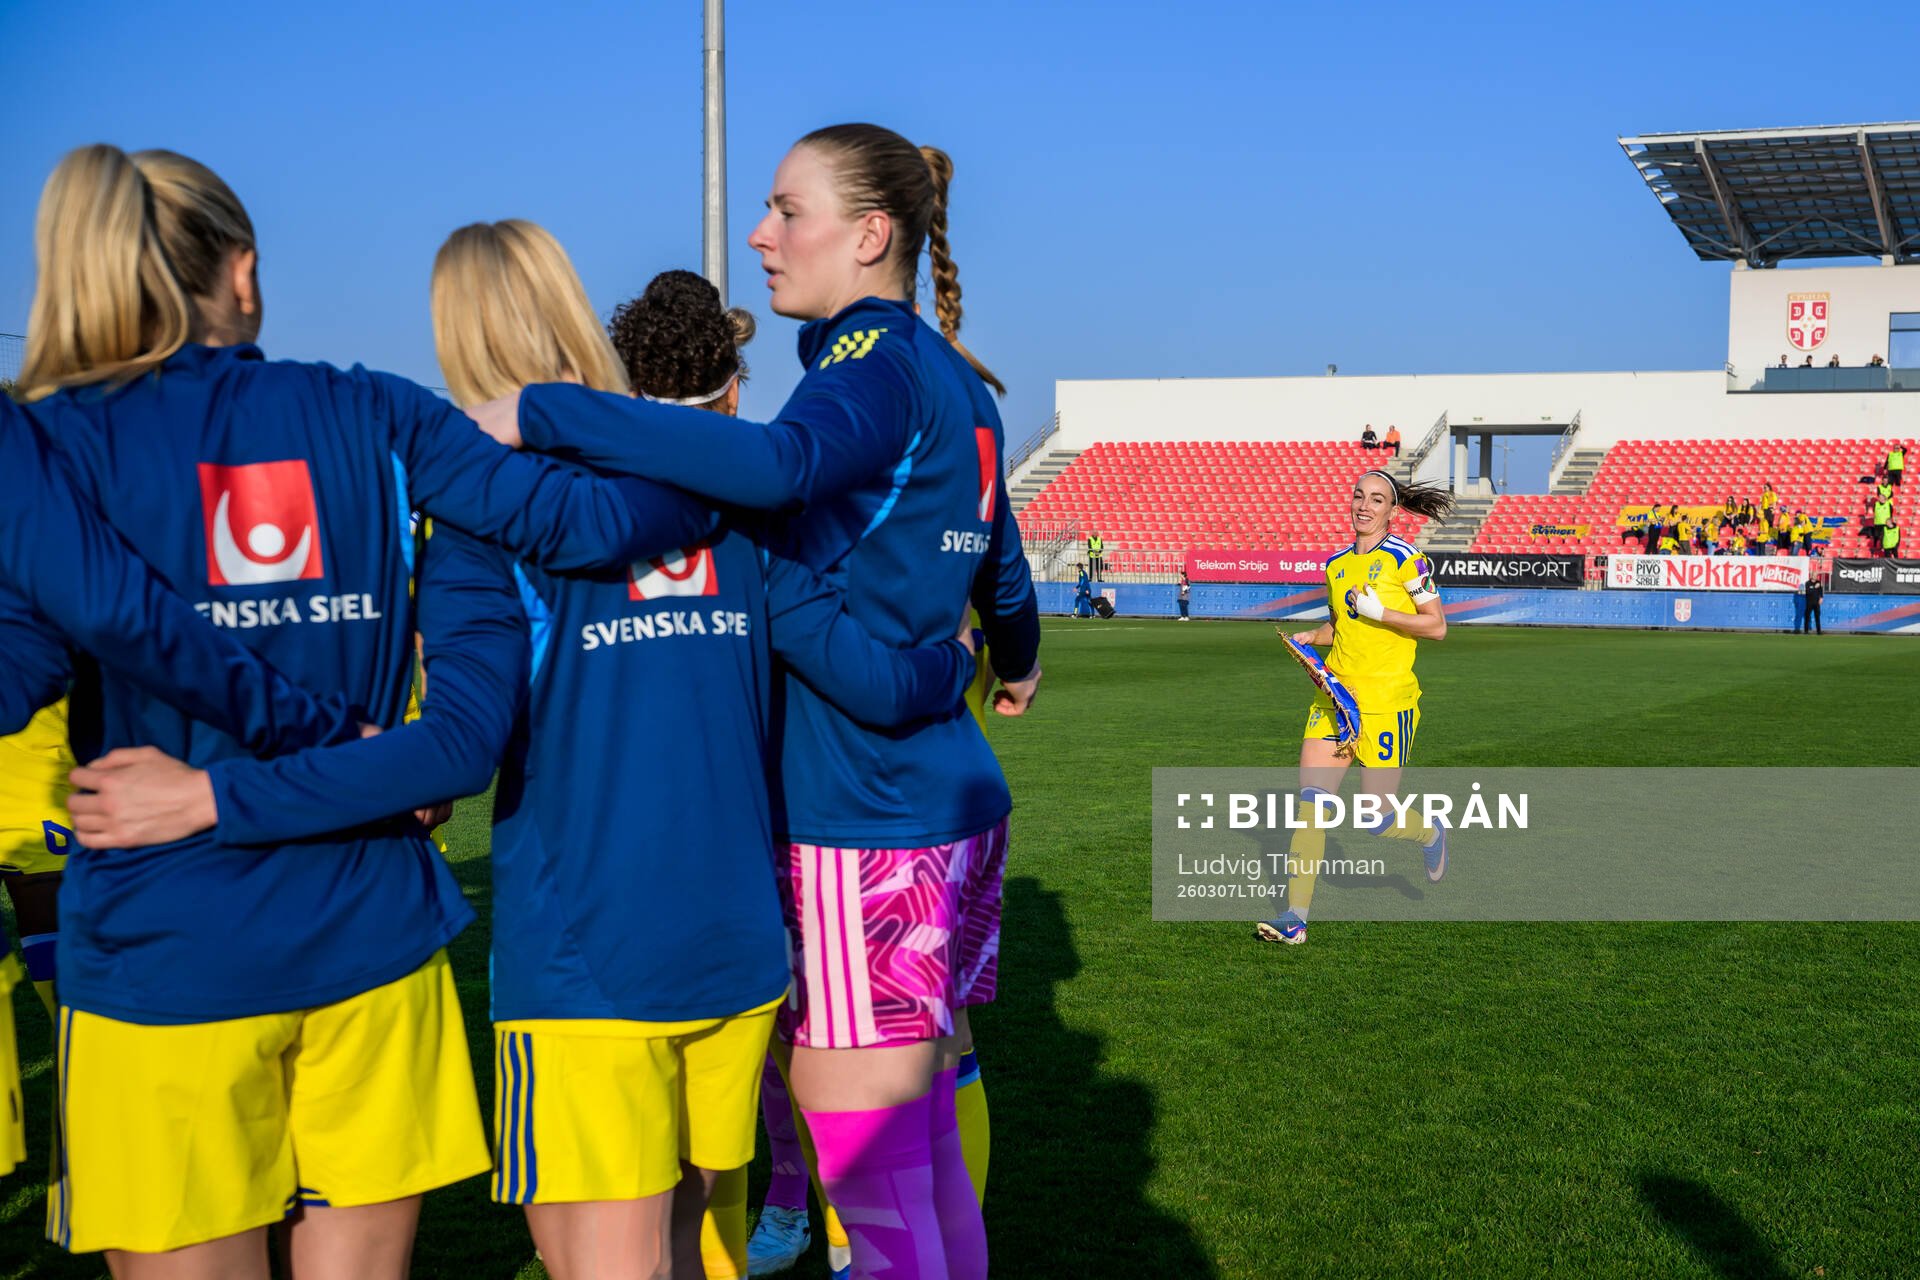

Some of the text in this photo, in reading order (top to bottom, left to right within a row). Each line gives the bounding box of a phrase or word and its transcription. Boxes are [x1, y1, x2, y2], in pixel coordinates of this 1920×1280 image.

[1195, 560, 1268, 573] Telekom Srbija
[1280, 561, 1292, 570] tu
[1295, 560, 1317, 573] gde
[1636, 564, 1660, 575] PIVO
[1664, 558, 1763, 587] Nektar
[1839, 567, 1882, 581] capelli
[581, 610, 749, 651] SVENSKA SPE
[1378, 731, 1394, 761] 9
